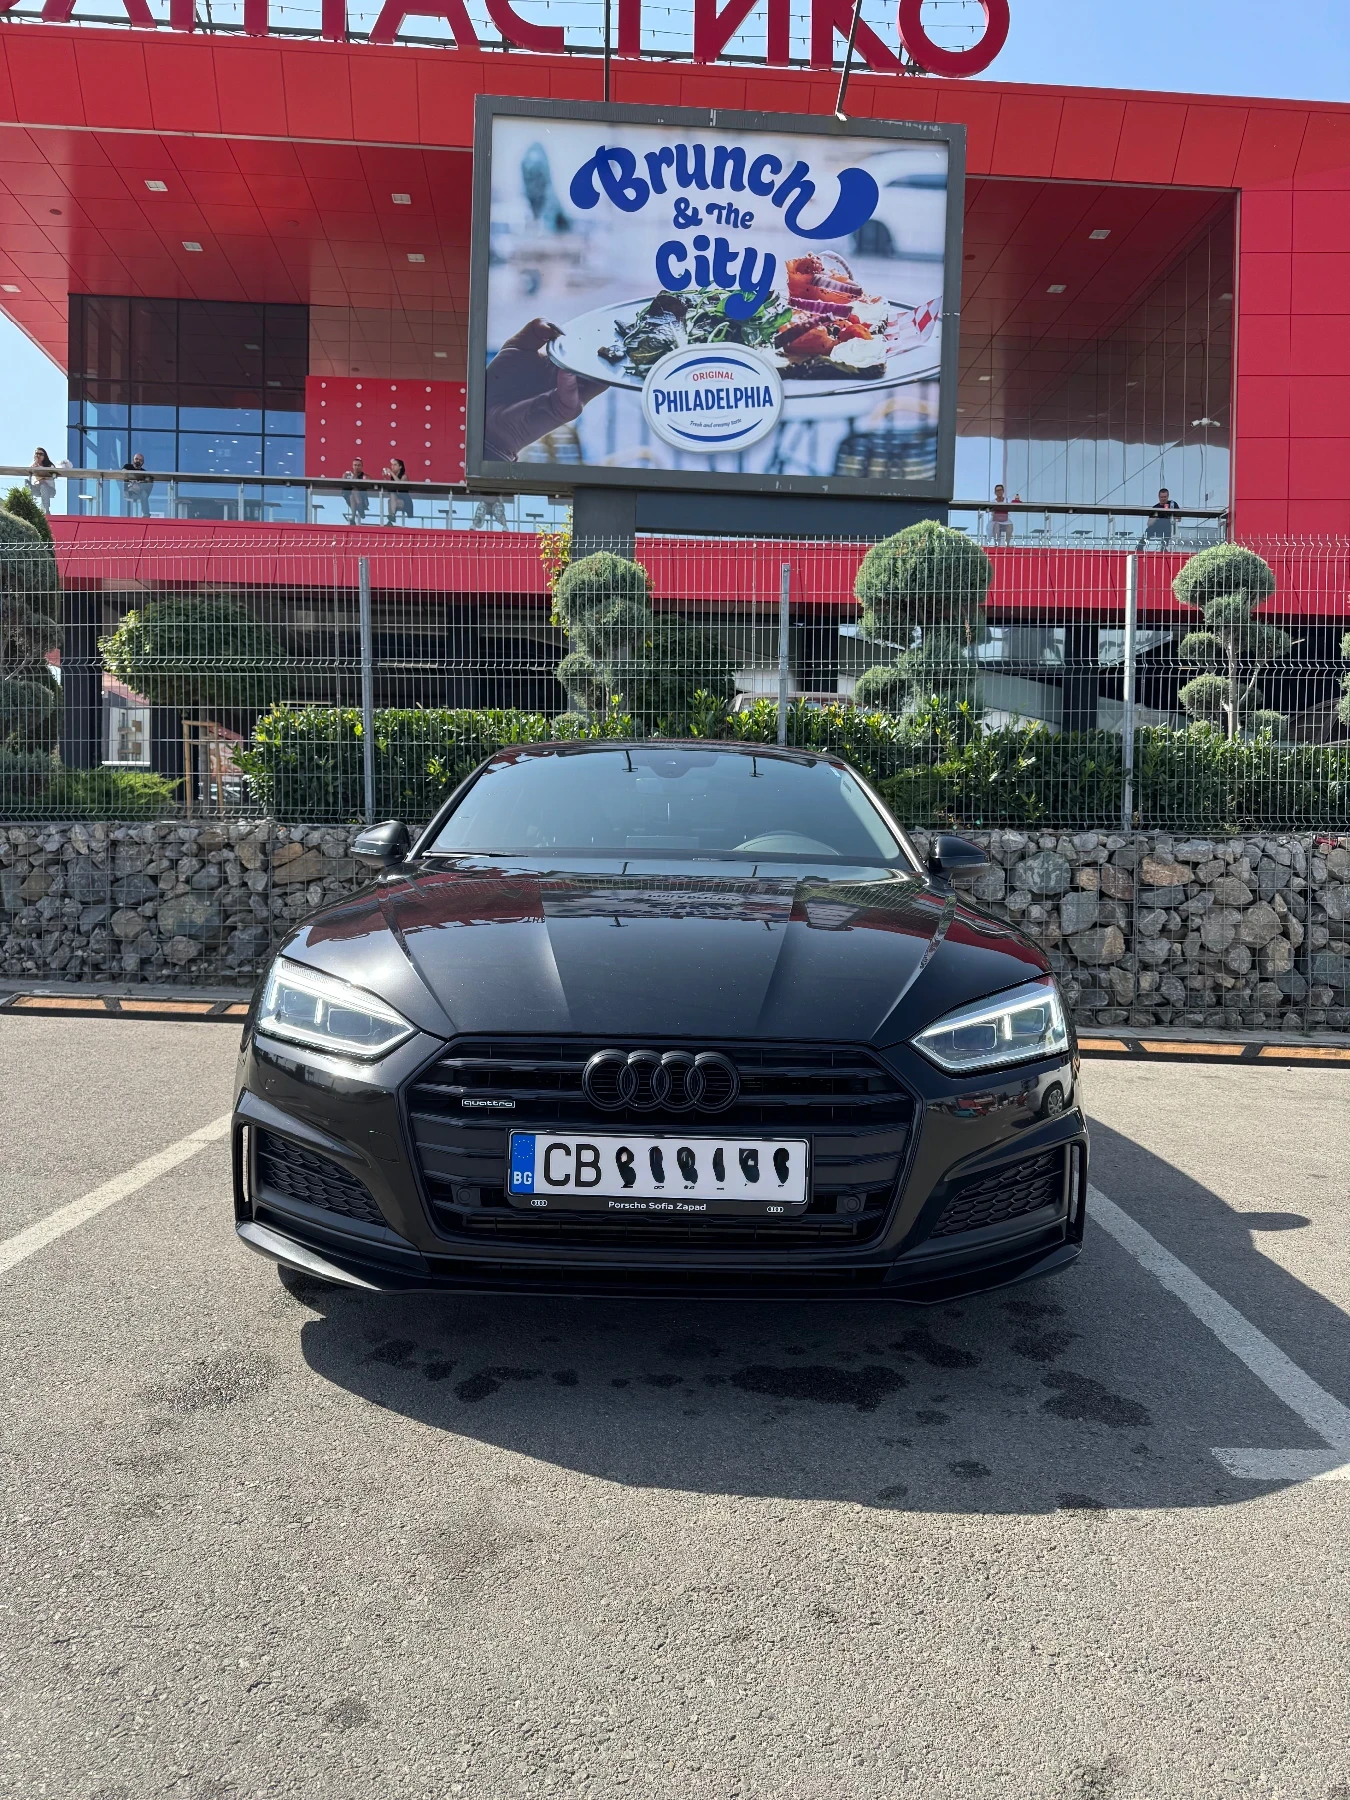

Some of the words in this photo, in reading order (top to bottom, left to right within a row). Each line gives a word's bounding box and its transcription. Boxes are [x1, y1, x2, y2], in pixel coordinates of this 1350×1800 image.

[569, 143, 879, 240] Brunch
[673, 197, 703, 229] &
[705, 202, 755, 229] The
[692, 371, 734, 382] ORIGINAL
[652, 386, 774, 415] PHILADELPHIA
[513, 1171, 533, 1185] BG
[608, 1201, 647, 1210] Porsche
[649, 1202, 674, 1211] Sofia
[676, 1203, 707, 1213] Zapad
